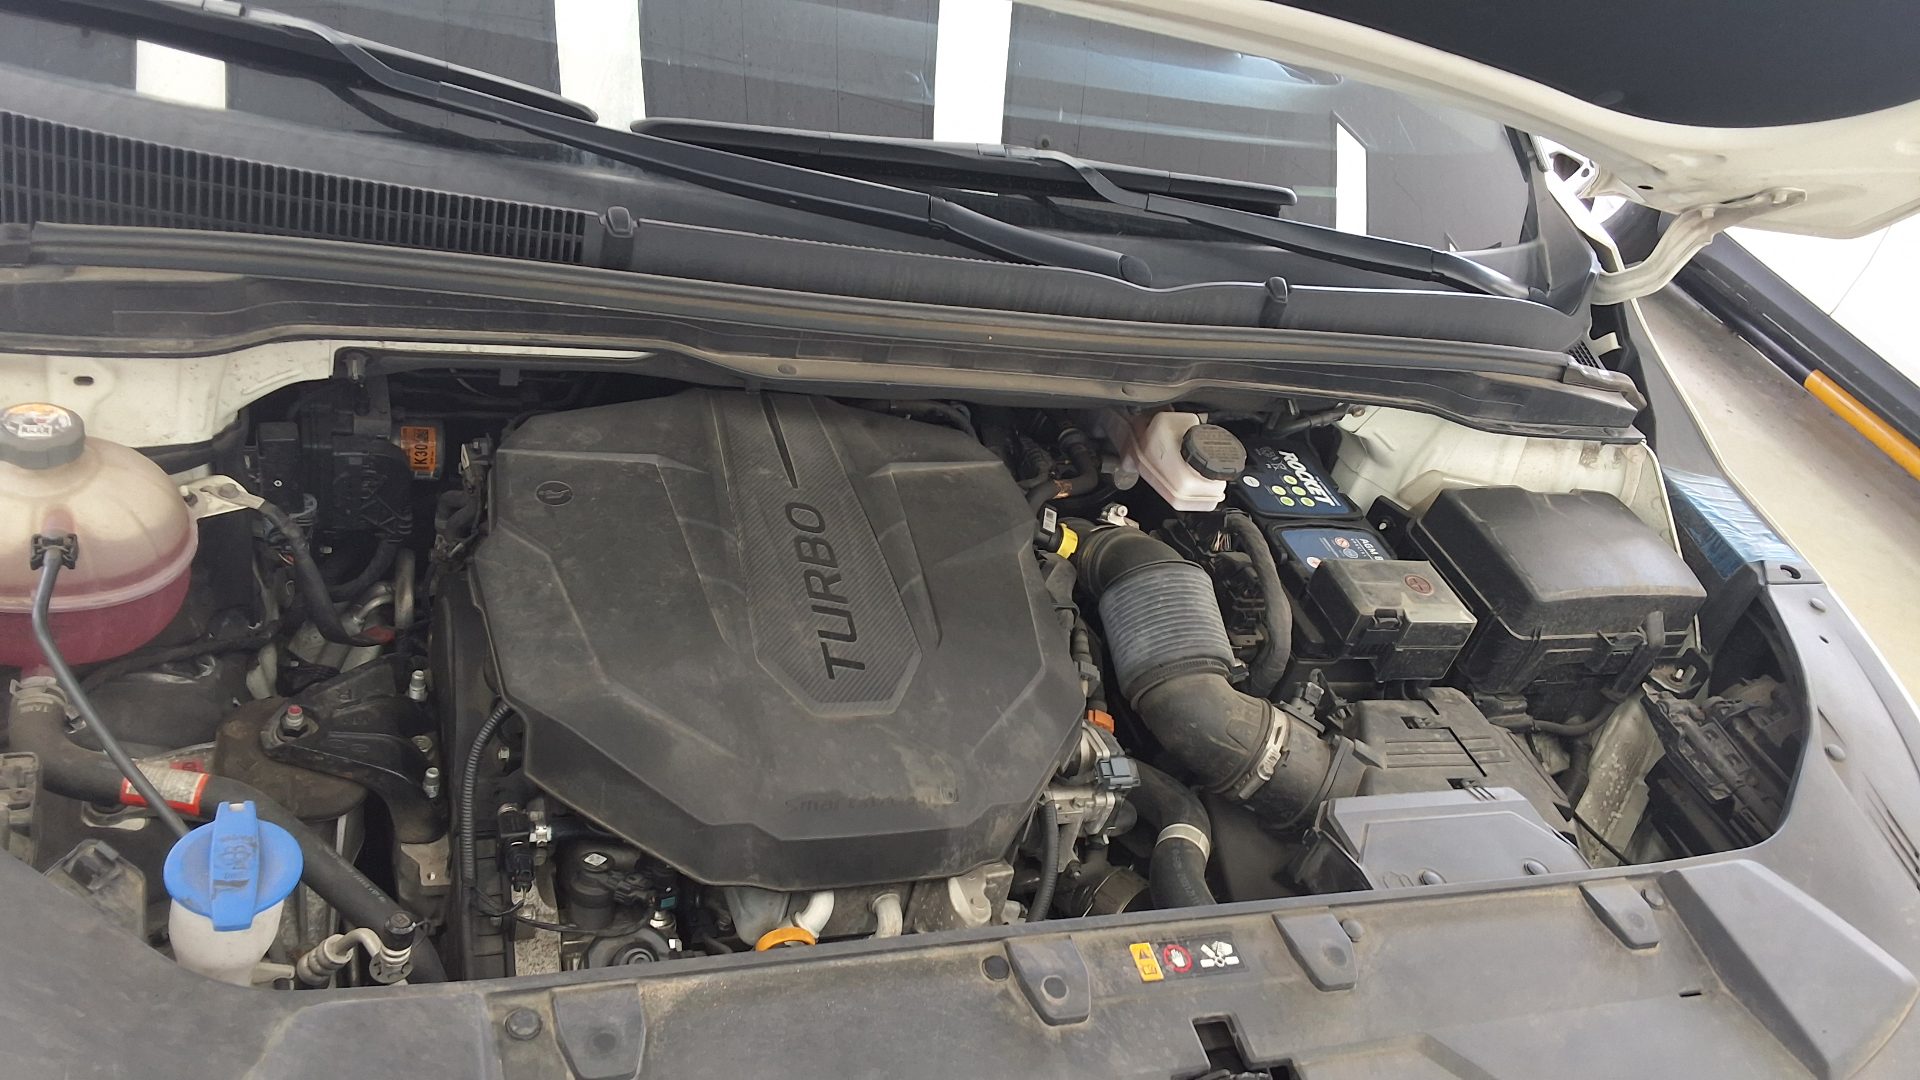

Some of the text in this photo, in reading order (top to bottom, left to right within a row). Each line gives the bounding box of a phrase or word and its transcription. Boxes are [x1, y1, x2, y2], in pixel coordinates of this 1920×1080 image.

[414, 444, 428, 465] K30
[1278, 450, 1336, 507] ROCKET
[1359, 538, 1379, 557] AGM
[785, 502, 865, 680] TURBO
